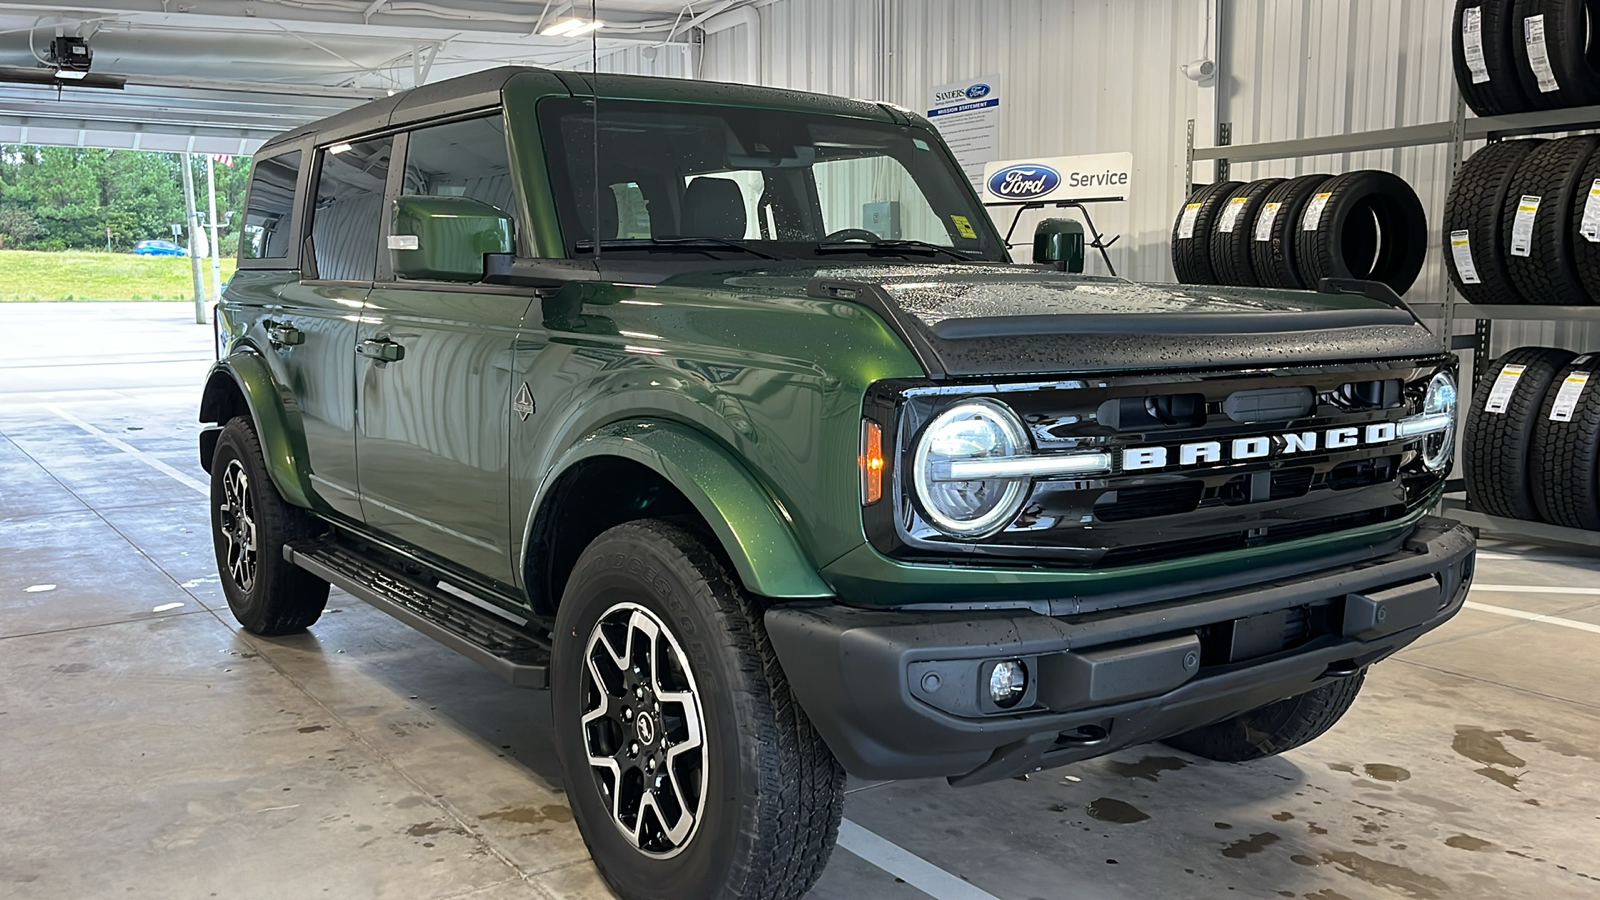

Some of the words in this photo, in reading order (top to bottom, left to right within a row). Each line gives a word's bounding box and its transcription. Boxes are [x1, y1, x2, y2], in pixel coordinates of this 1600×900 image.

[935, 88, 965, 101] SANDERS
[937, 106, 958, 115] MISSION
[958, 101, 988, 111] STATEMENT
[1000, 169, 1047, 195] Ford
[1069, 169, 1128, 187] Service
[1122, 422, 1396, 470] BRONCO
